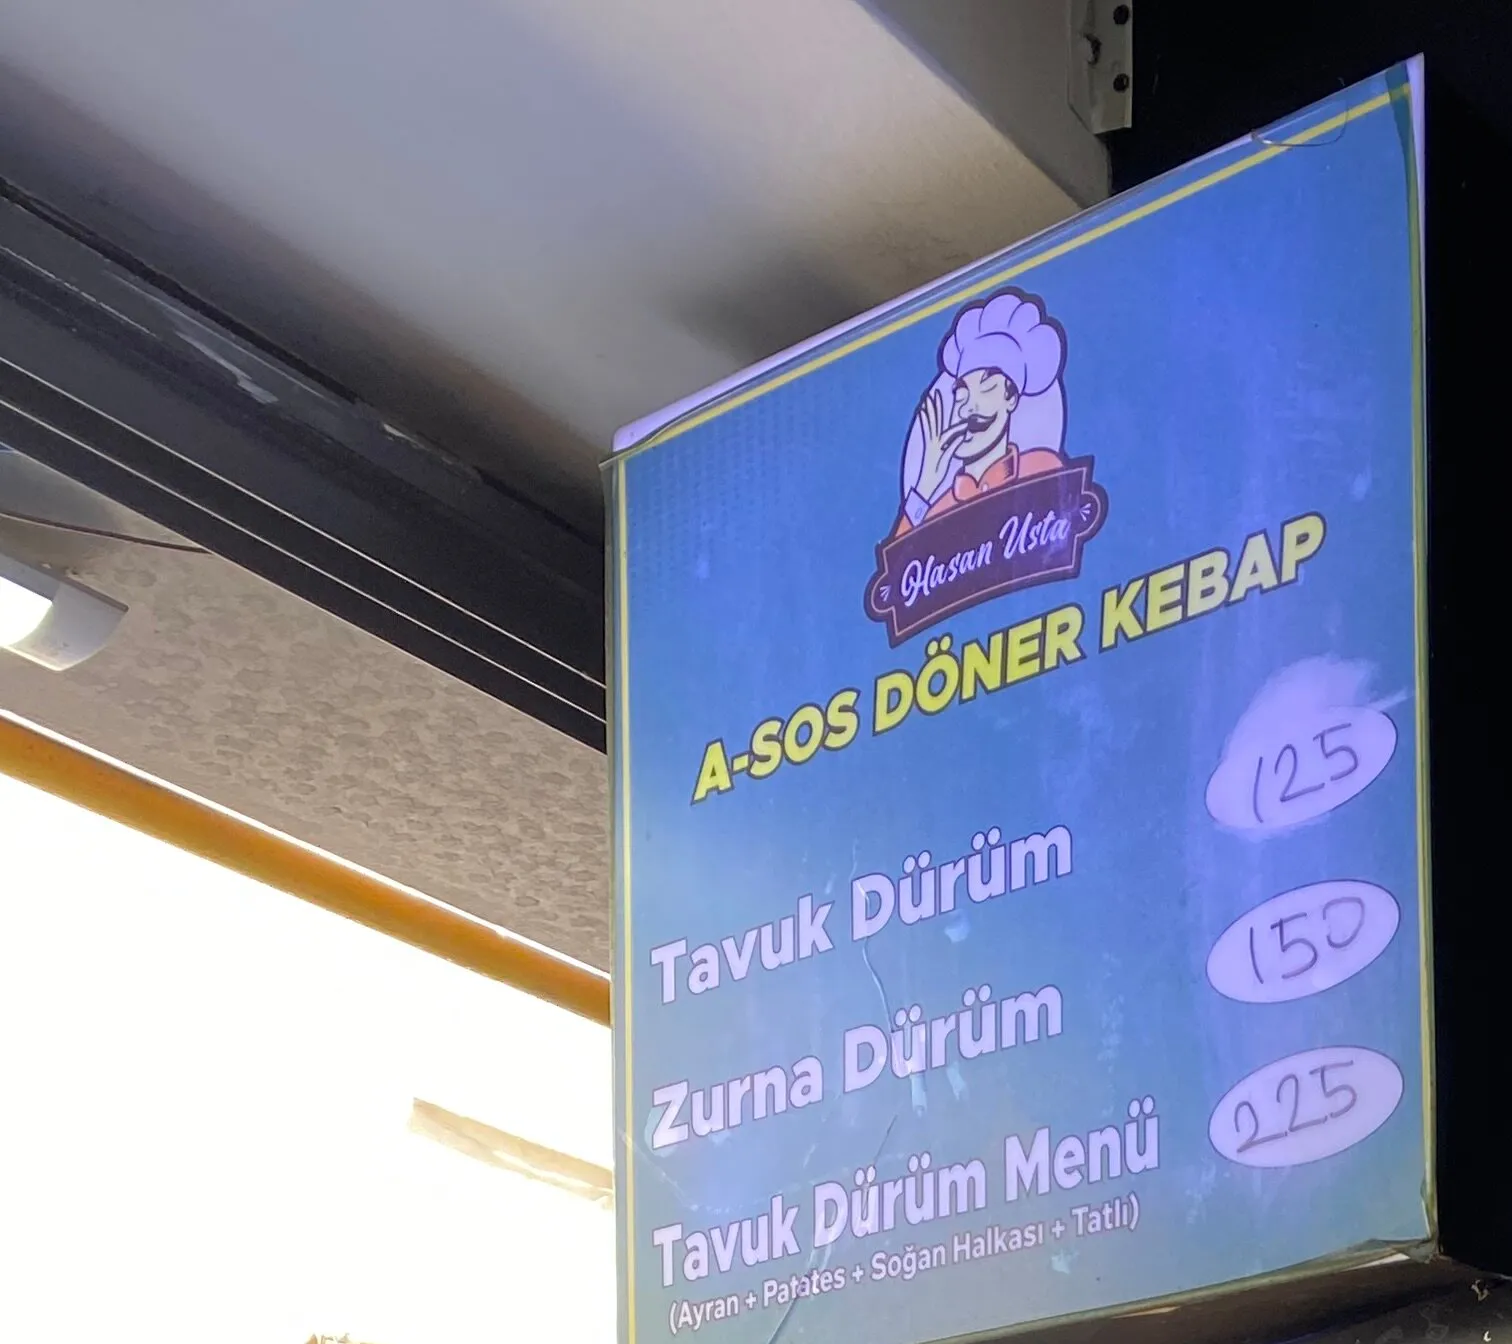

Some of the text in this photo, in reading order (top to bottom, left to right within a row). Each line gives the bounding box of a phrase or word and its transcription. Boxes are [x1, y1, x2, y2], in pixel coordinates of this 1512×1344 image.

[901, 510, 1071, 607] Hasan Usta
[690, 511, 1327, 805] A-SOS DÖNER KEBAP
[1251, 722, 1362, 822] 125
[651, 824, 1073, 1003] Tavuk Dürüm
[1246, 896, 1367, 985] 150
[651, 984, 1064, 1149] Zurna Dürüm
[1233, 1062, 1359, 1153] 225
[653, 1095, 1160, 1286] Tavuk Dürüm Menü
[669, 1193, 1140, 1335] (Ayran + Patates + Soğan Halkası + Tatlı)
